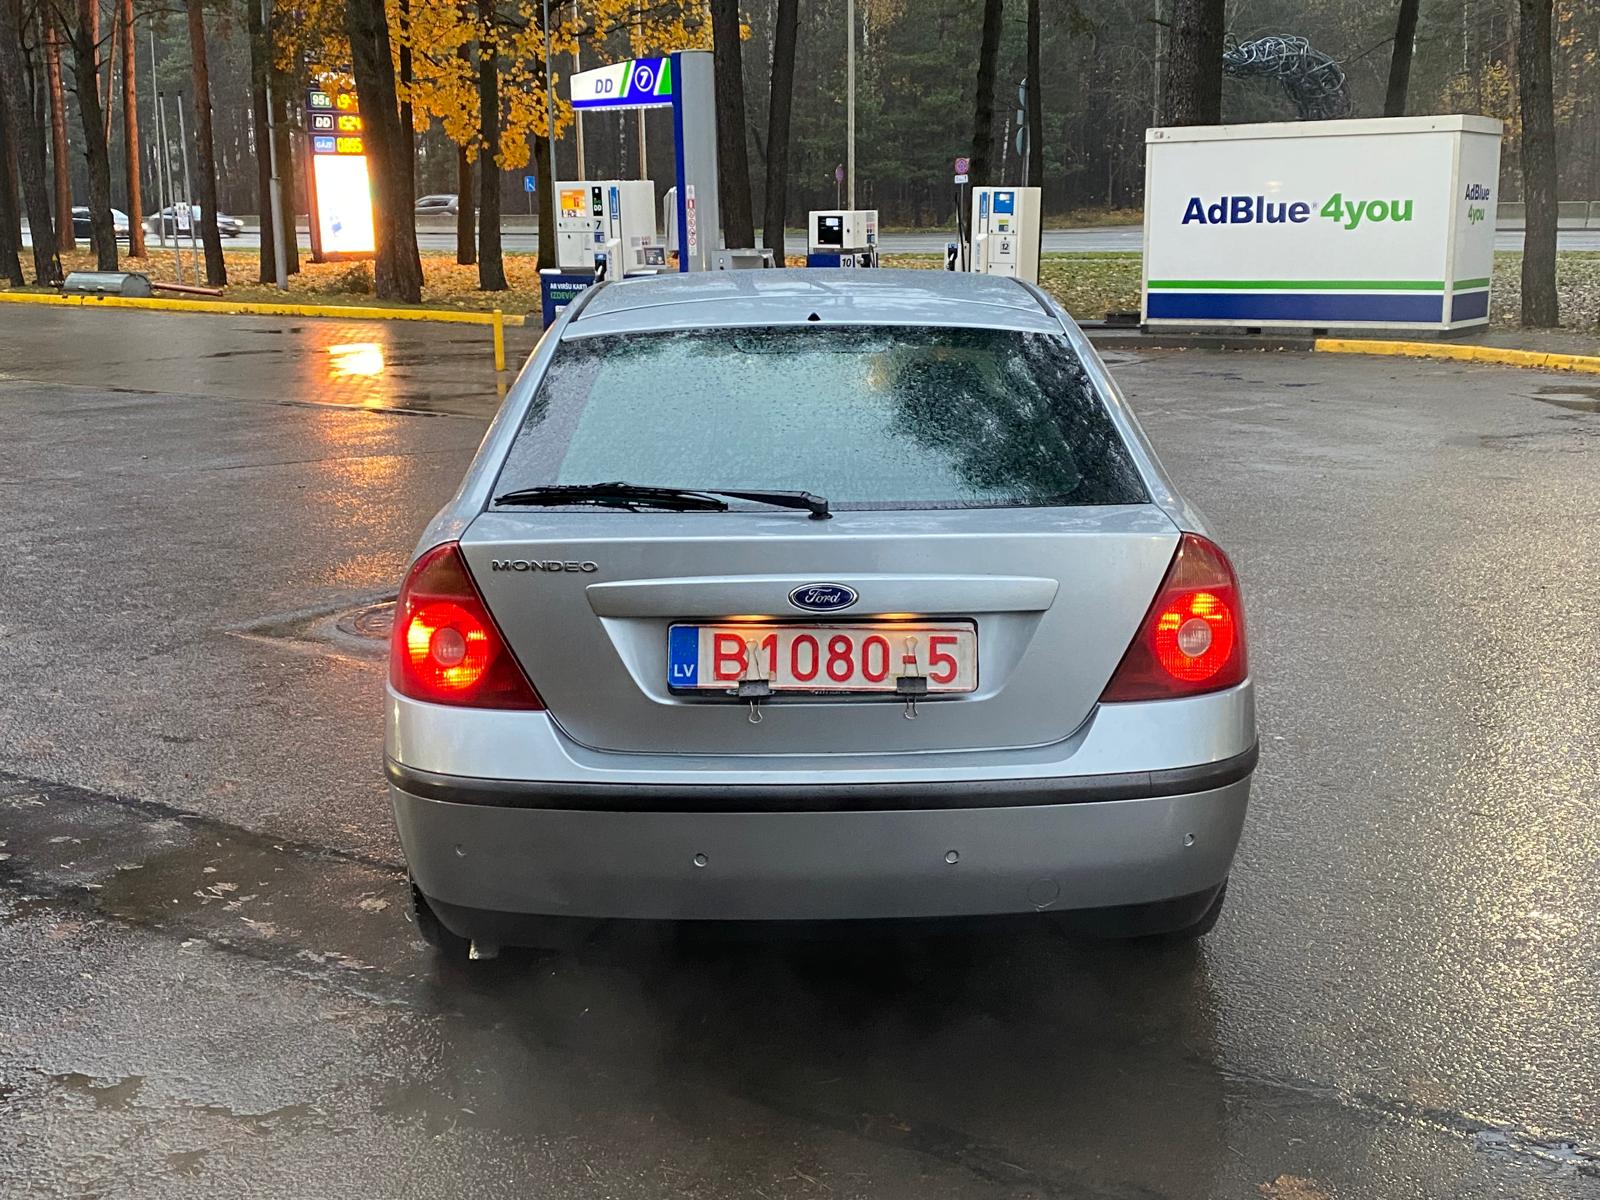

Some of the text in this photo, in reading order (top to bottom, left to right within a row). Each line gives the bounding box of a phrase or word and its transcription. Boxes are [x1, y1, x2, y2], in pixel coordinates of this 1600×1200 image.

[595, 78, 613, 94] DD
[315, 116, 331, 128] DD
[1464, 184, 1490, 201] AdBlue
[1320, 192, 1414, 231] 4you
[1467, 204, 1485, 225] 4you
[595, 221, 602, 230] 7
[841, 258, 852, 268] 10
[491, 559, 599, 573] MONDEO
[804, 588, 841, 603] Ford
[673, 663, 695, 677] LV
